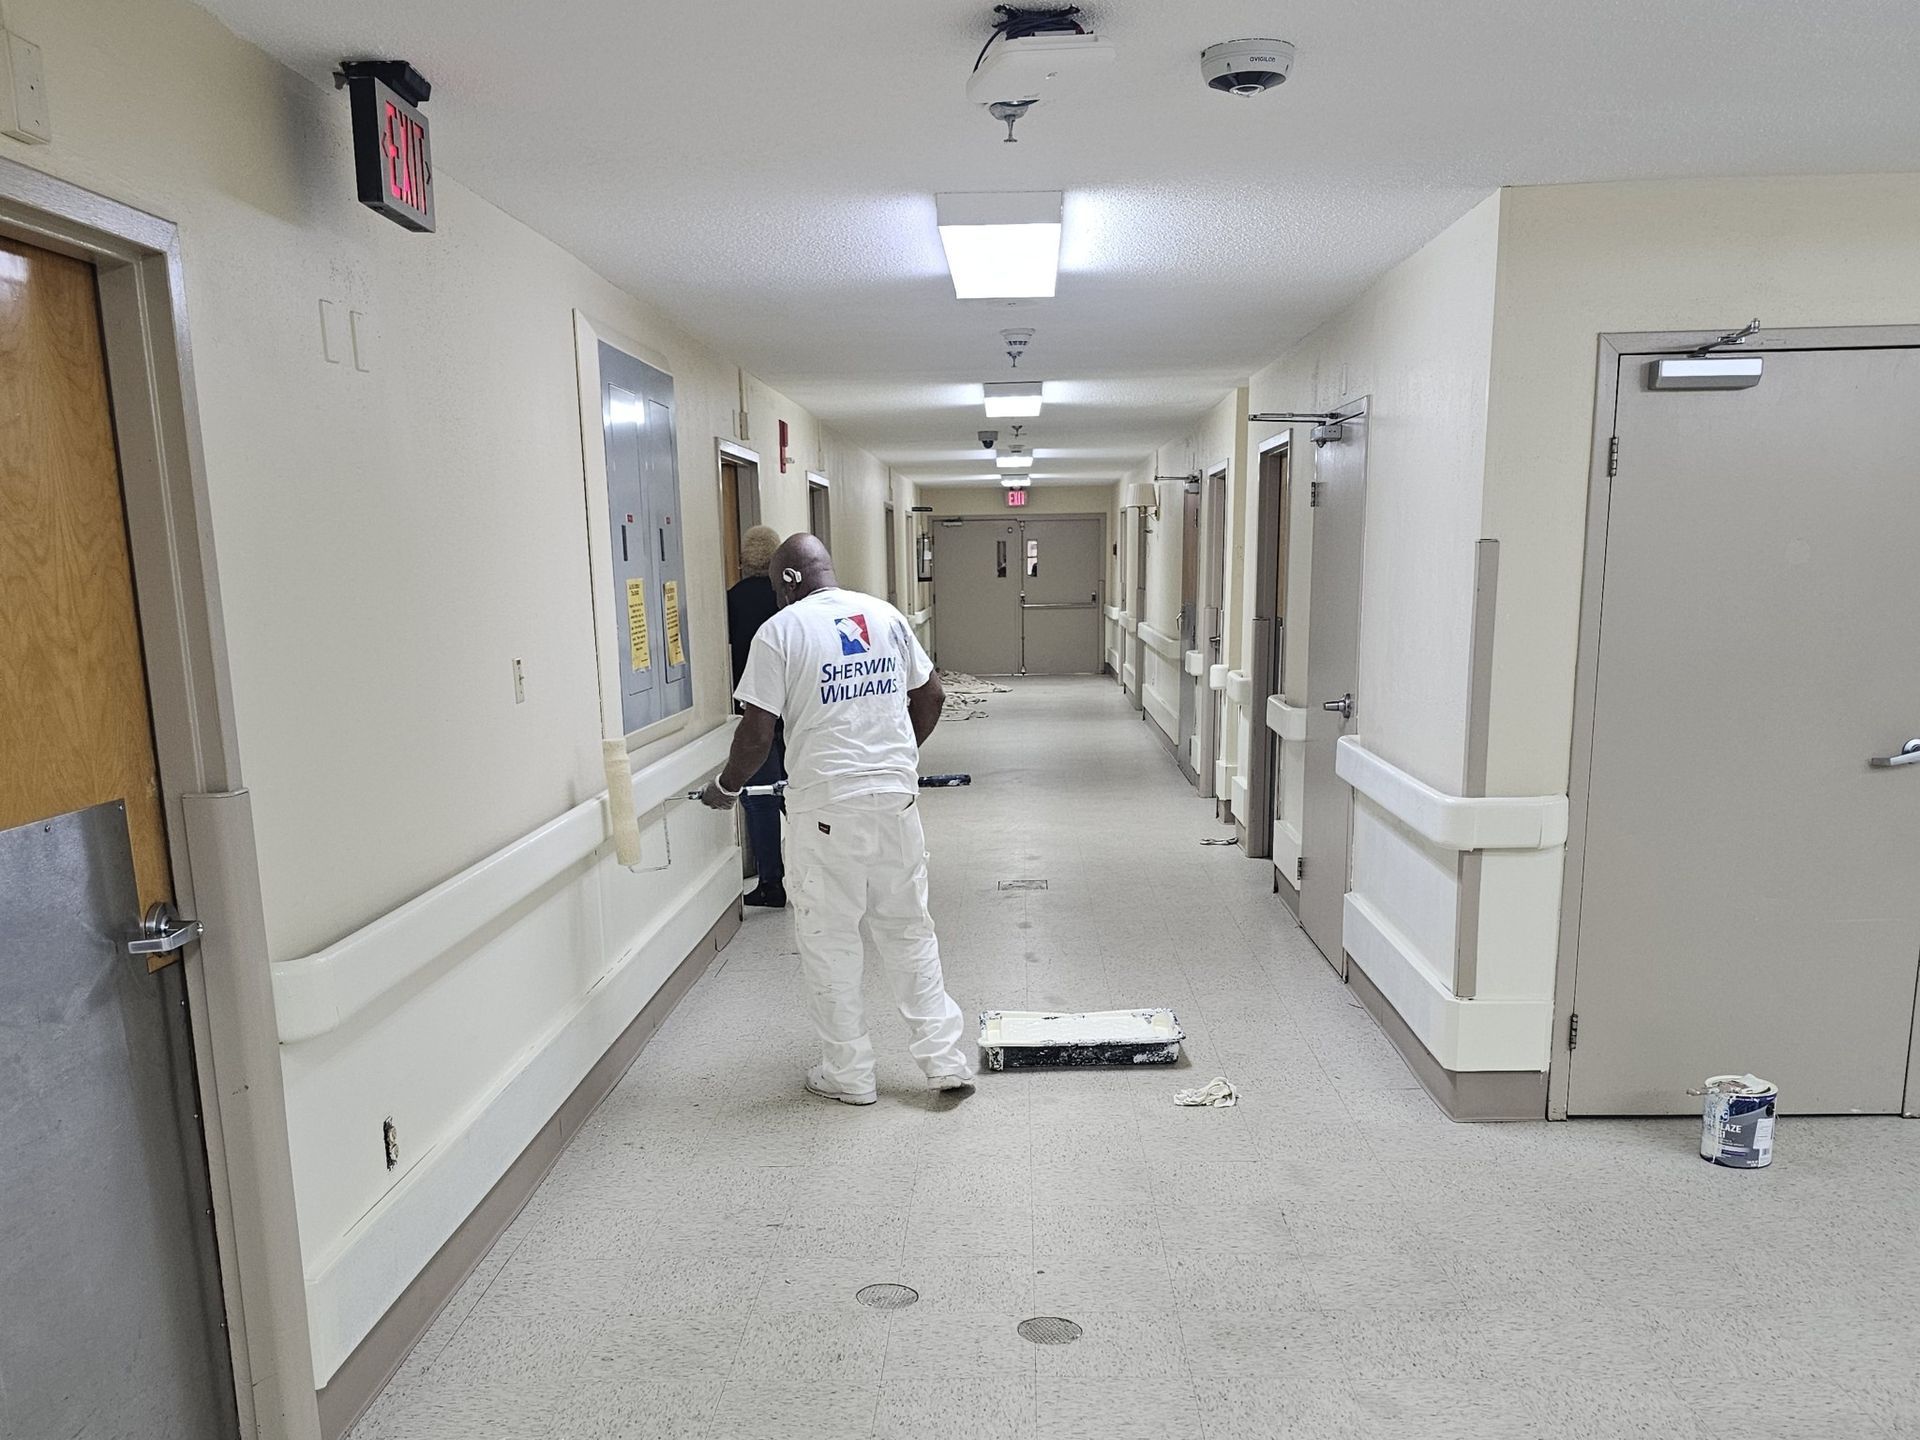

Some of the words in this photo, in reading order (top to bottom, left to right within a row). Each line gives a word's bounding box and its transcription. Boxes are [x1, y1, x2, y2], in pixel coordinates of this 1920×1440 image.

[385, 100, 427, 216] EXIT
[1008, 491, 1025, 505] EXIT
[821, 657, 896, 683] SHERWIN
[820, 678, 897, 704] WILLIAMS
[1720, 1122, 1742, 1133] LAZE
